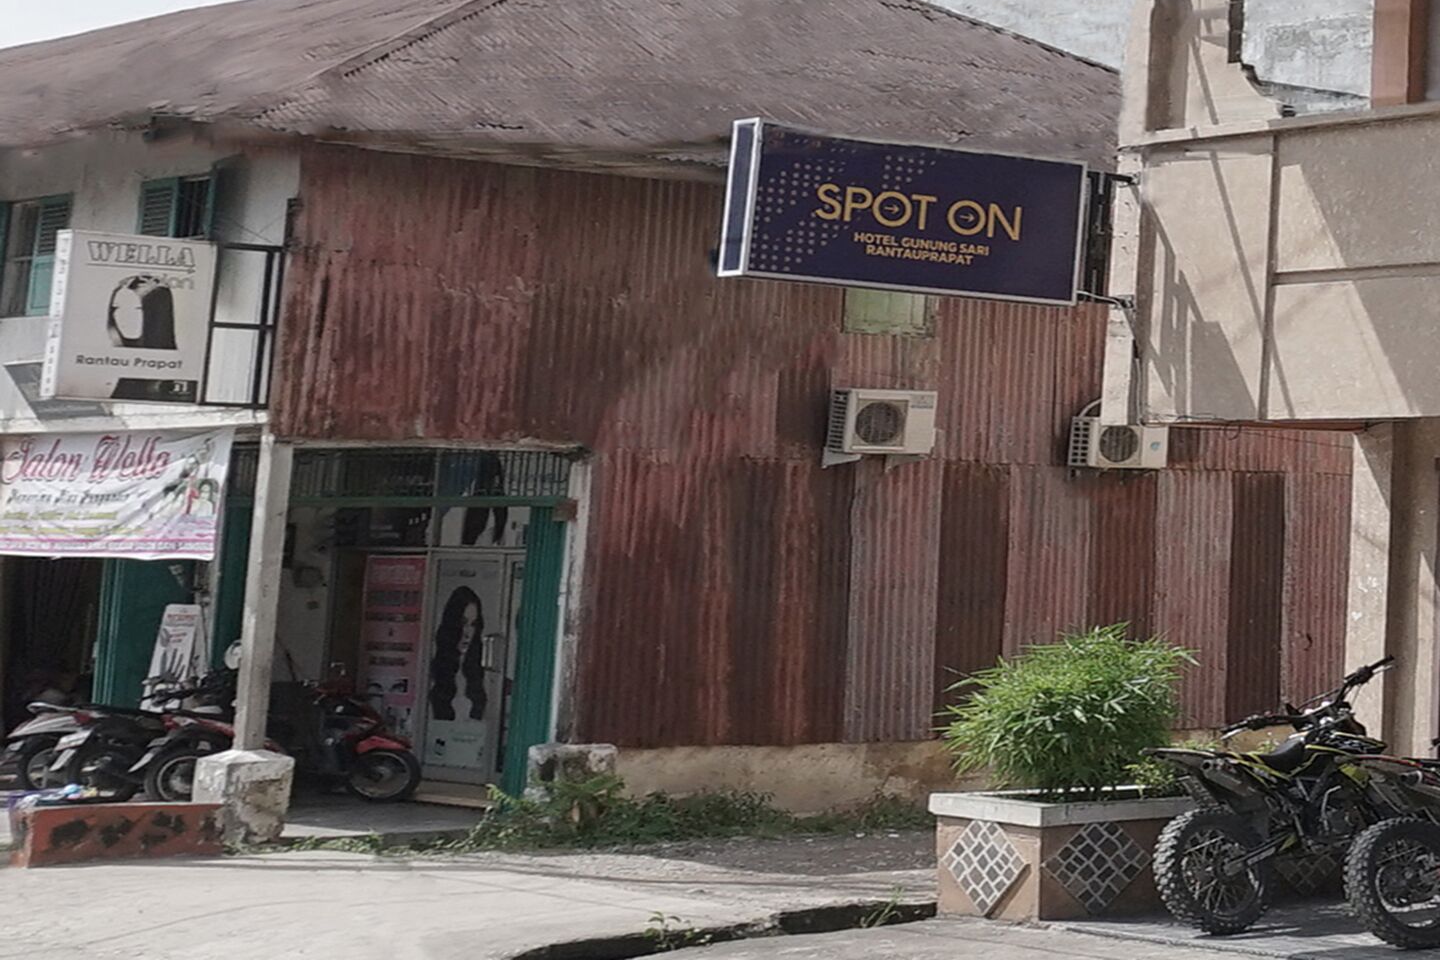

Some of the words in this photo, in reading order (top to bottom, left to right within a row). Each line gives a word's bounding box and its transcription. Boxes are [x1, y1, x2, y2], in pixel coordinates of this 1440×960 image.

[815, 183, 938, 231] SPOT
[947, 199, 1022, 241] ON
[87, 240, 196, 268] WELLA
[853, 232, 899, 247] HOTEL
[901, 237, 957, 253] GUNUNG
[959, 243, 990, 257] SARI
[866, 244, 974, 266] RANTAUPRAPAT
[75, 354, 130, 367] Rantau
[133, 357, 183, 370] Prapat
